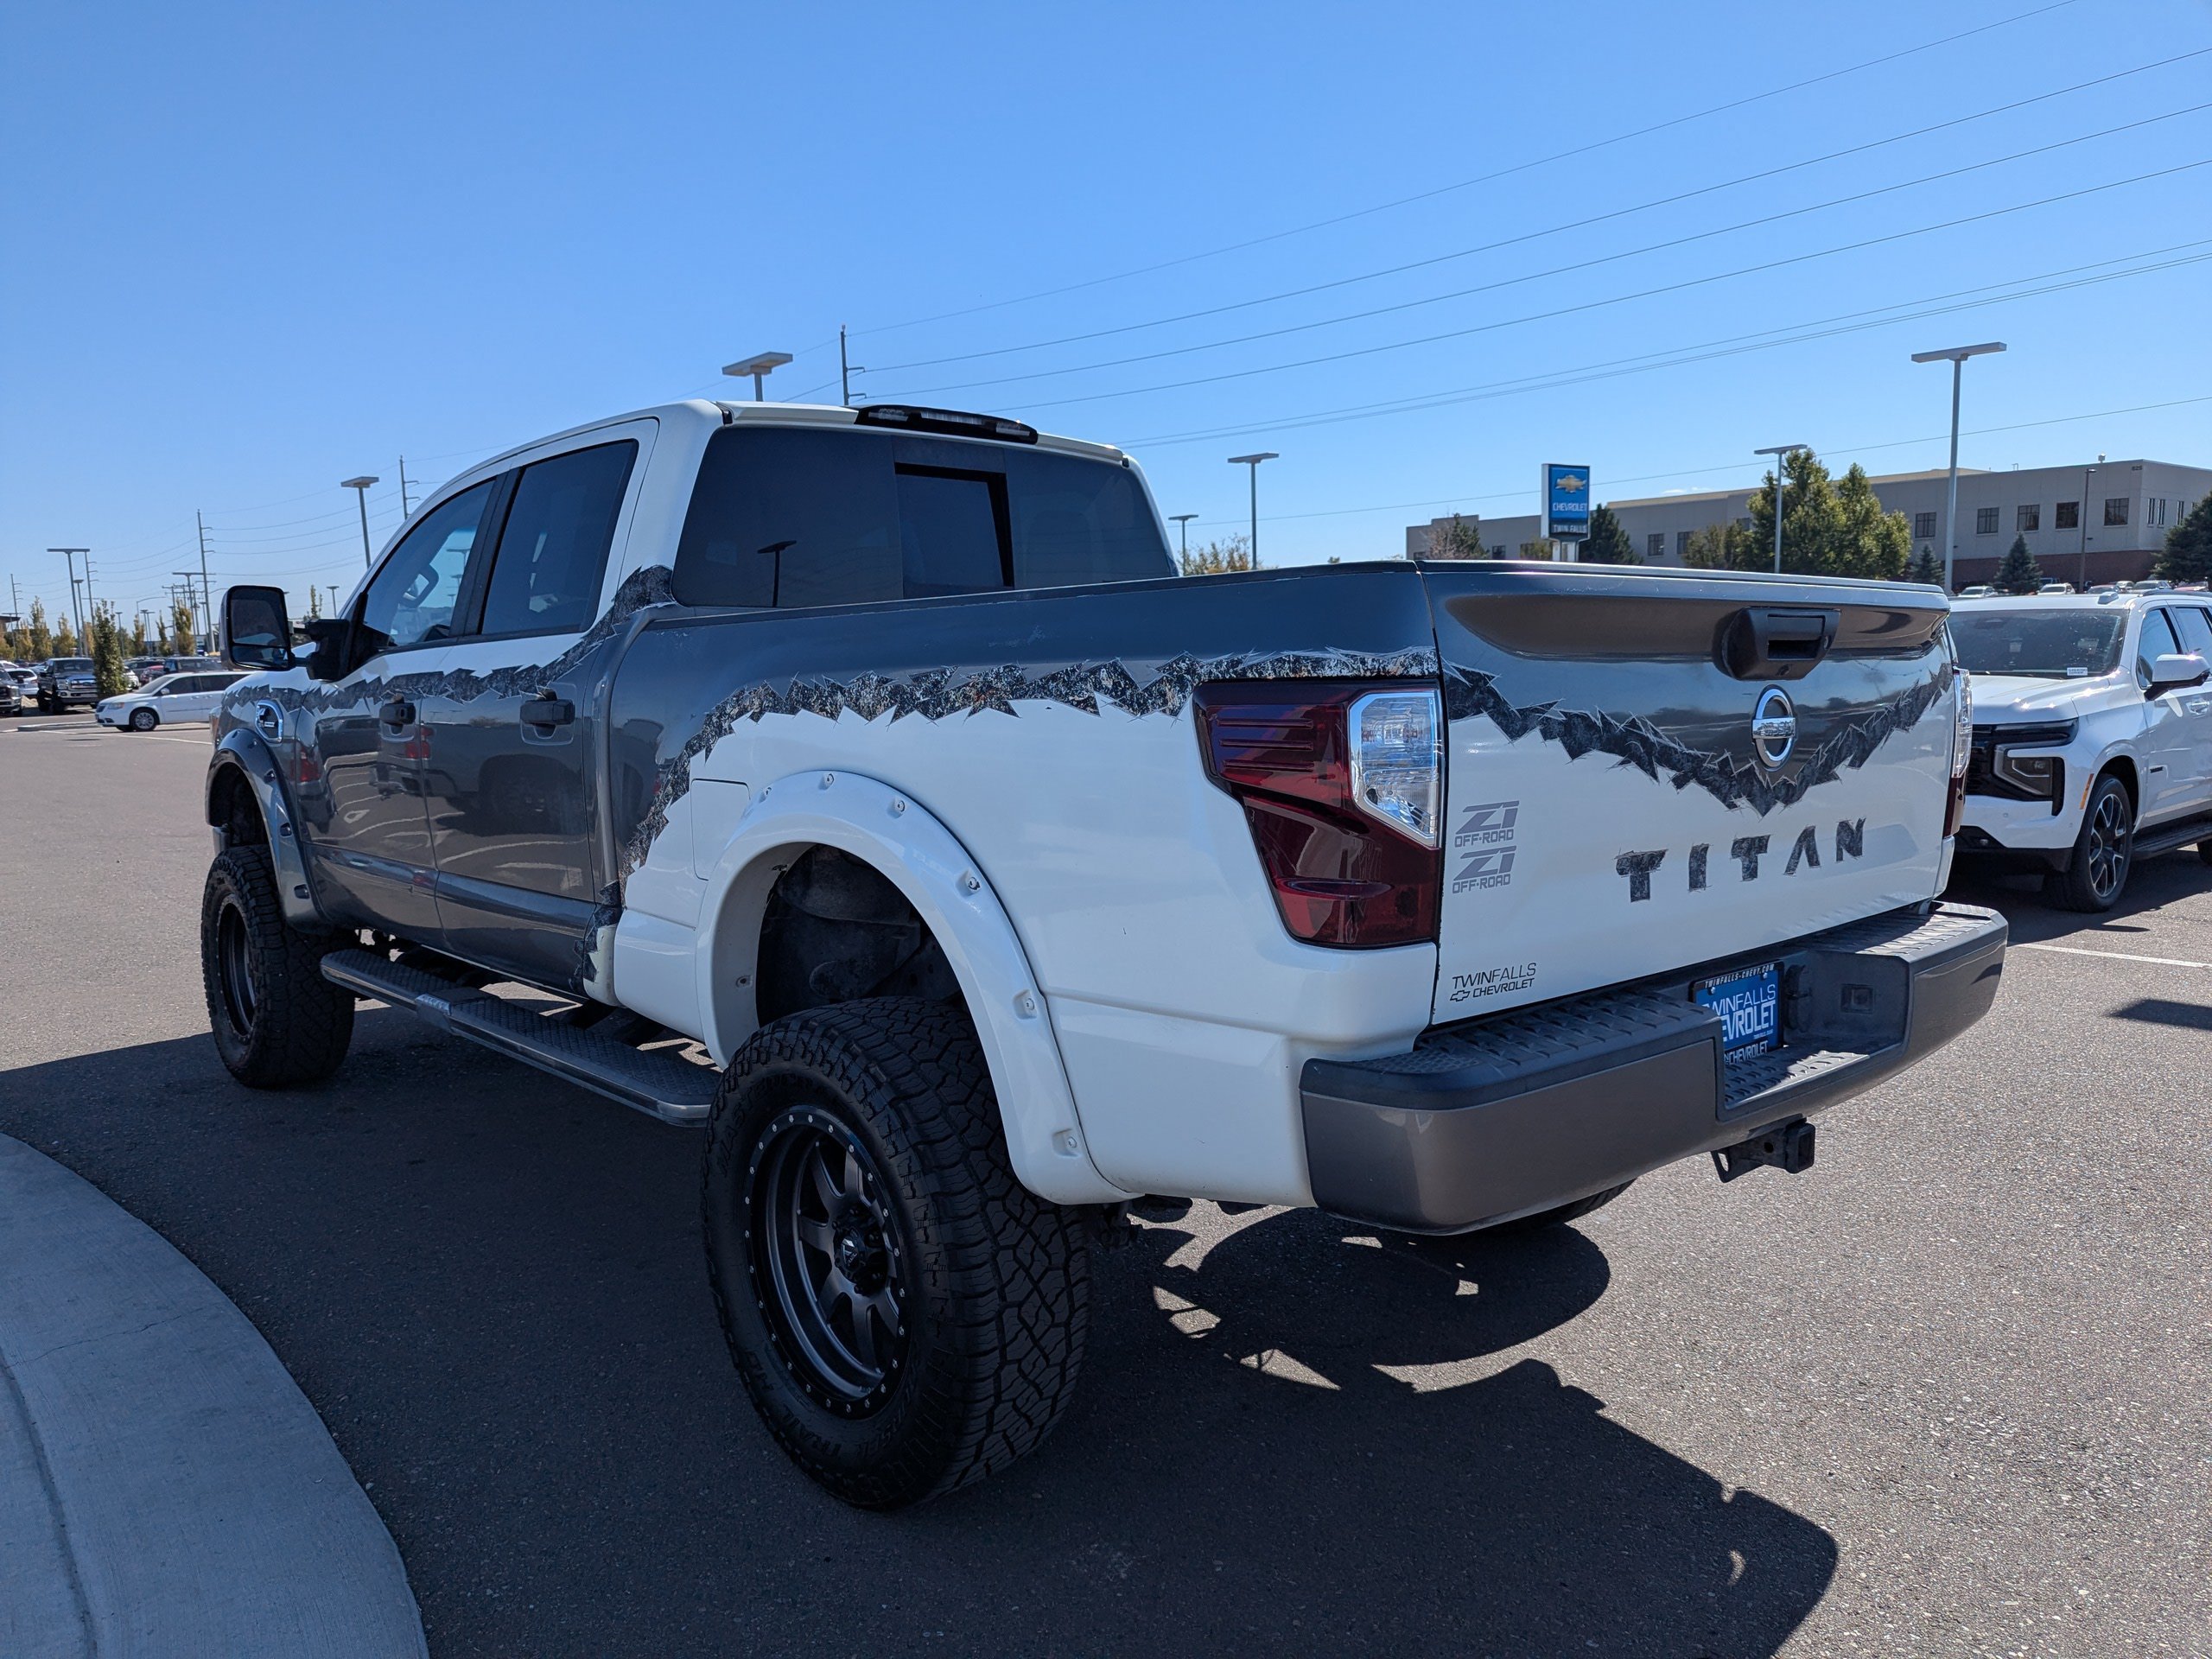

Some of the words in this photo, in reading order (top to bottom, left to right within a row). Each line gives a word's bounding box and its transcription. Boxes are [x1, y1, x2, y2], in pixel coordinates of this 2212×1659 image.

[1552, 503, 1588, 512] CHEVROLET
[1554, 524, 1568, 533] TWIN
[1569, 524, 1587, 533] FALLS
[1614, 817, 1866, 903] TITAN
[1452, 962, 1536, 989] TWINFALLS
[1472, 977, 1535, 998] CHEVROLET
[1705, 963, 1775, 988] TWINFALLS-CHEVY.COM
[1701, 983, 1776, 1016] WINFALLS
[1720, 999, 1776, 1040] EVROLET
[1729, 1040, 1768, 1065] CHEVROLET
